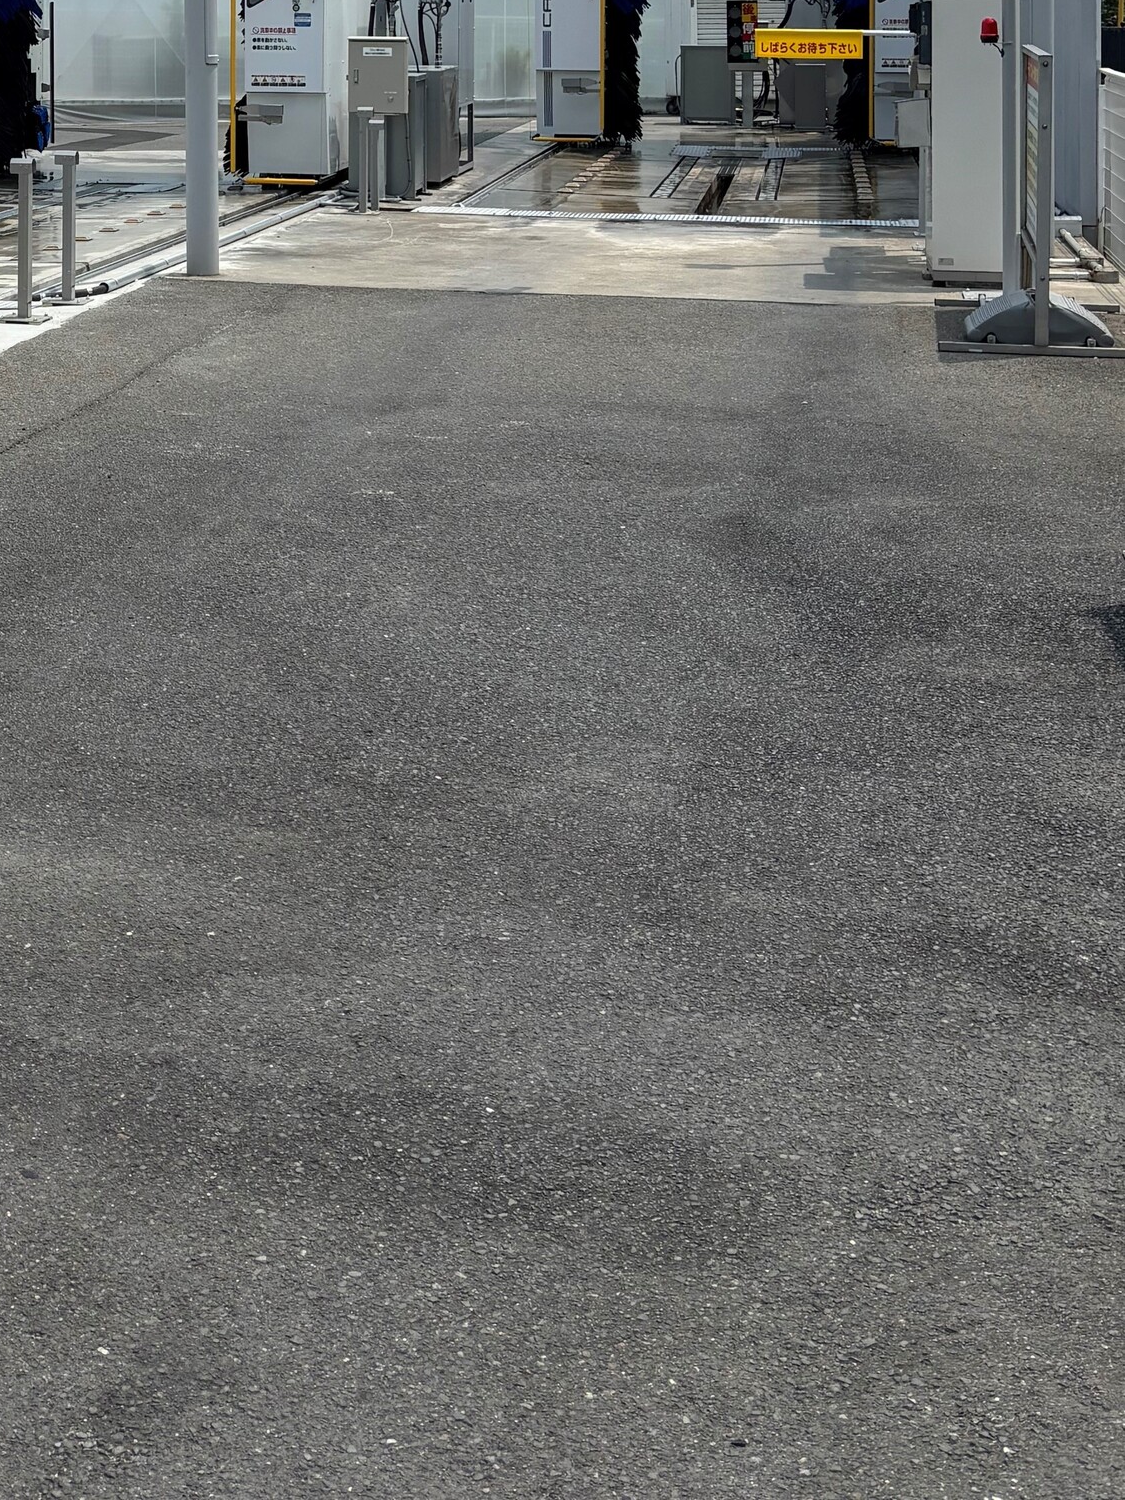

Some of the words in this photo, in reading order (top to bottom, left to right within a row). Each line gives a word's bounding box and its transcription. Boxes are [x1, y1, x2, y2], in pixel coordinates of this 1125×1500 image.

[760, 41, 858, 55] しばらくお待ち下さい
